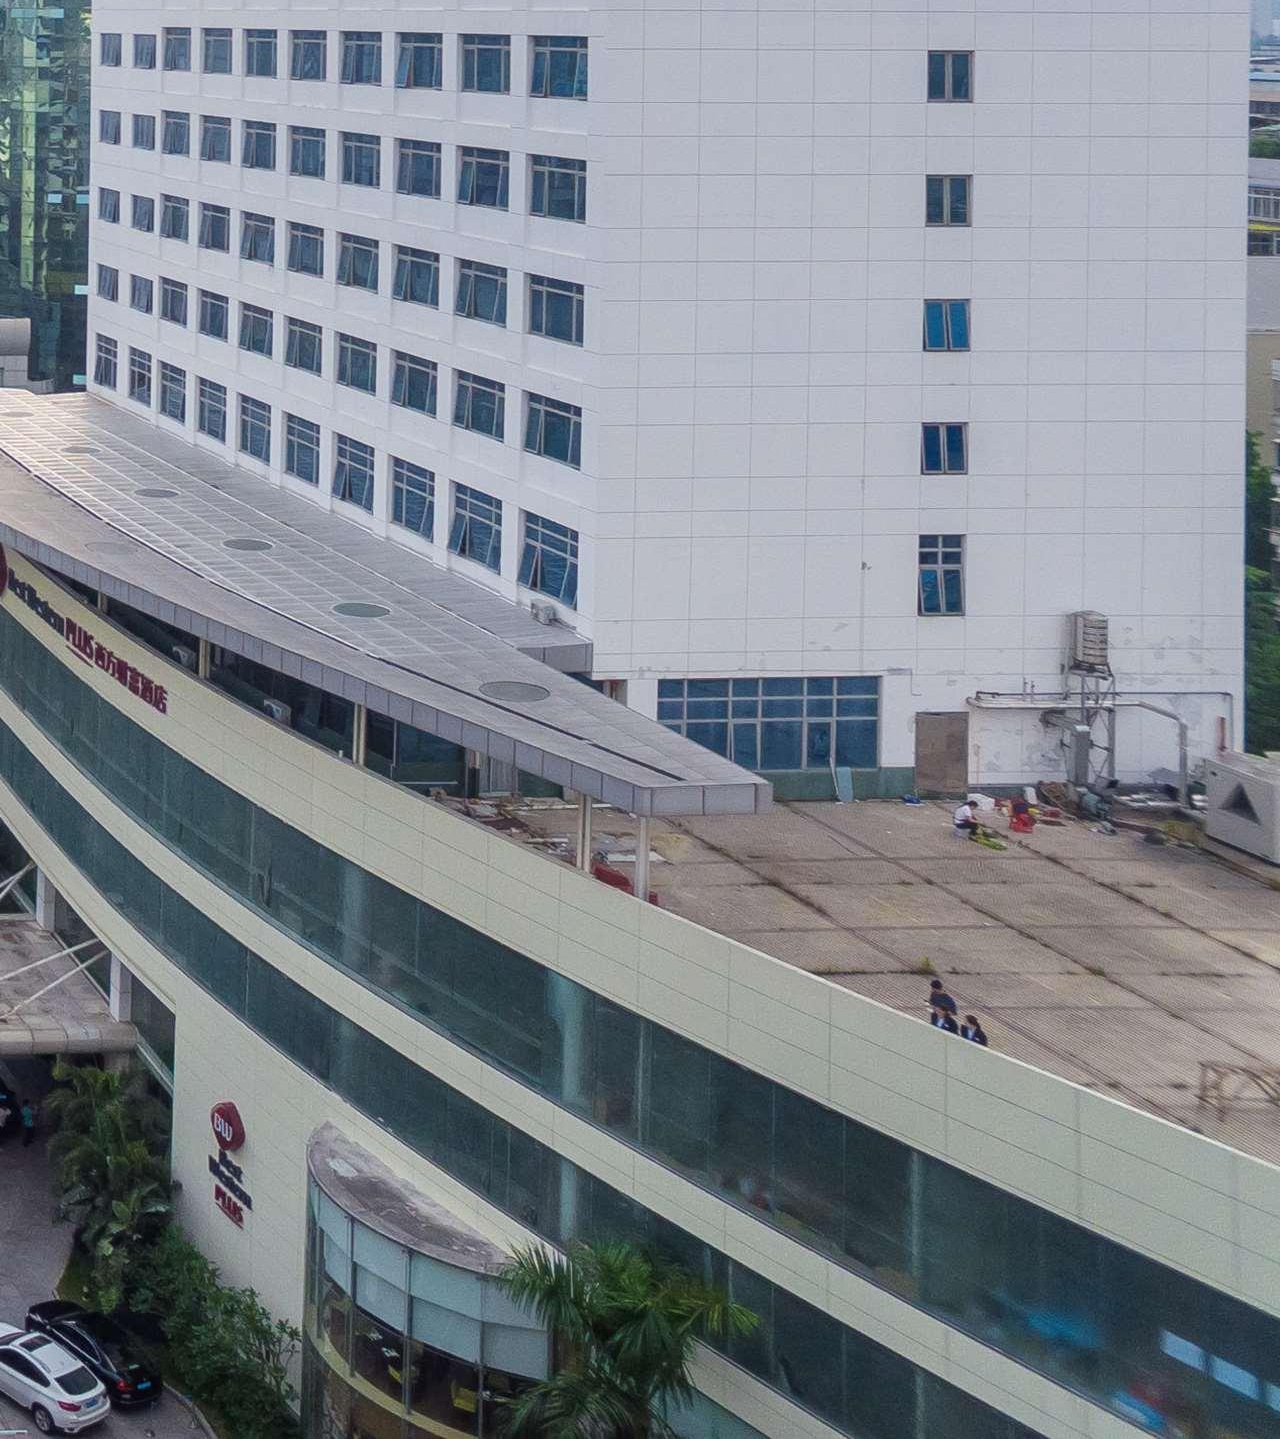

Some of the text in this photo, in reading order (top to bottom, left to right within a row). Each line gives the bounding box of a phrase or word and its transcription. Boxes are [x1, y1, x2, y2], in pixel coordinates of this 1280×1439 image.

[65, 617, 94, 659] PLUS
[213, 1113, 233, 1142] BW
[214, 1183, 245, 1225] PLUS
